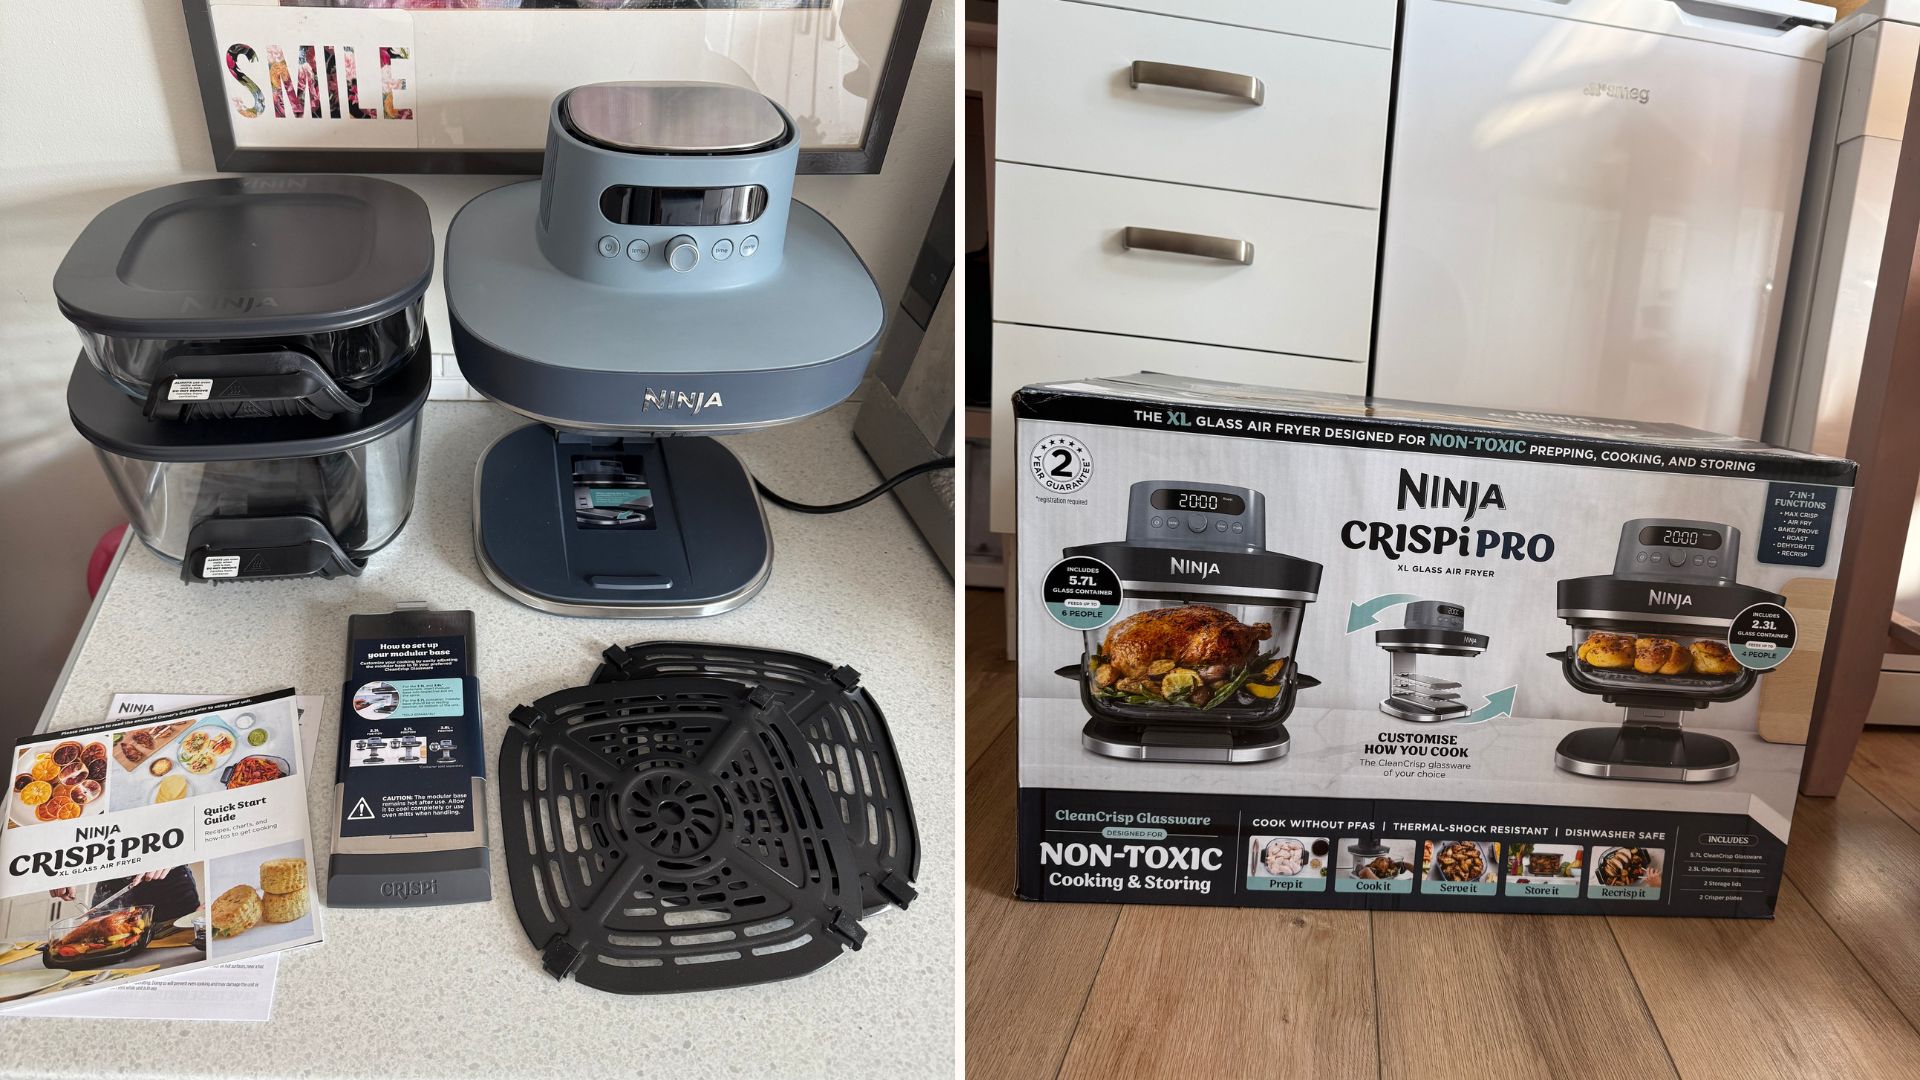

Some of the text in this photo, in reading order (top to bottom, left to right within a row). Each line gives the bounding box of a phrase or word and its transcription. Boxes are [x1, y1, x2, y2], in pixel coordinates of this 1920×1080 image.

[226, 43, 413, 120] SMILE
[642, 387, 723, 416] NINJA
[1134, 410, 1757, 473] THE XL GLASS AIR FRYER DESIGNED FOR NON-TOXIC PREPPING, COOKING, AND STORING
[1033, 455, 1045, 480] YEAR
[1051, 449, 1072, 477] 2
[1397, 467, 1507, 522] NINJA
[1789, 490, 1815, 499] 7-IN-1
[1774, 498, 1827, 510] FUNCTIONS
[1776, 542, 1815, 551] DEHYDRATE
[1066, 566, 1100, 574] INCLUDES
[1170, 556, 1221, 579] NINJA
[1397, 564, 1495, 578] XL GLASS AIR FRYER
[1069, 575, 1097, 586] 5.7L
[1075, 588, 1113, 596] CONTAINER
[1648, 589, 1692, 609] NINJA
[1069, 610, 1103, 618] PEOPLE
[1751, 619, 1777, 630] 2.3L
[1756, 631, 1789, 639] CONTAINER
[427, 642, 439, 650] up
[367, 651, 389, 659] your
[1748, 651, 1777, 659] PEOPLE
[118, 702, 155, 716] NINJA
[1378, 732, 1458, 745] CUSTOMISE
[1364, 744, 1469, 758] HOW YOU COOK
[1360, 758, 1471, 771] The CleanCrisp glassware
[1383, 768, 1446, 779] of your choice
[204, 797, 267, 816] Quick Start
[204, 814, 236, 825] Guide
[1055, 809, 1211, 826] CleanCrisp Glassware
[204, 827, 232, 836] Recipes,
[232, 822, 254, 830] charts,
[1252, 818, 1376, 830] COOK WITHOUT PFAS
[1393, 822, 1549, 835] THERMAL-SHOCK RESISTANT
[75, 824, 121, 843] NINJA
[204, 833, 231, 842] how-tos
[240, 828, 251, 836] get
[252, 822, 278, 832] cooking
[1106, 829, 1145, 837] DESIGNED
[1565, 828, 1666, 841] DISHWASHER SAFE
[1708, 835, 1749, 844] INCLUDES
[1040, 842, 1223, 871] NON-TOXIC
[71, 864, 98, 875] GLASS
[100, 862, 114, 870] AIR
[116, 857, 142, 867] FRYER
[1049, 872, 1212, 894] Cooking & Storing
[1269, 878, 1303, 889] Prep it
[1356, 881, 1391, 891] Cook it
[1440, 883, 1477, 893] Serve it
[1708, 880, 1731, 888] Storage
[1525, 885, 1559, 896] Store it
[1601, 887, 1646, 899] Recrisp it
